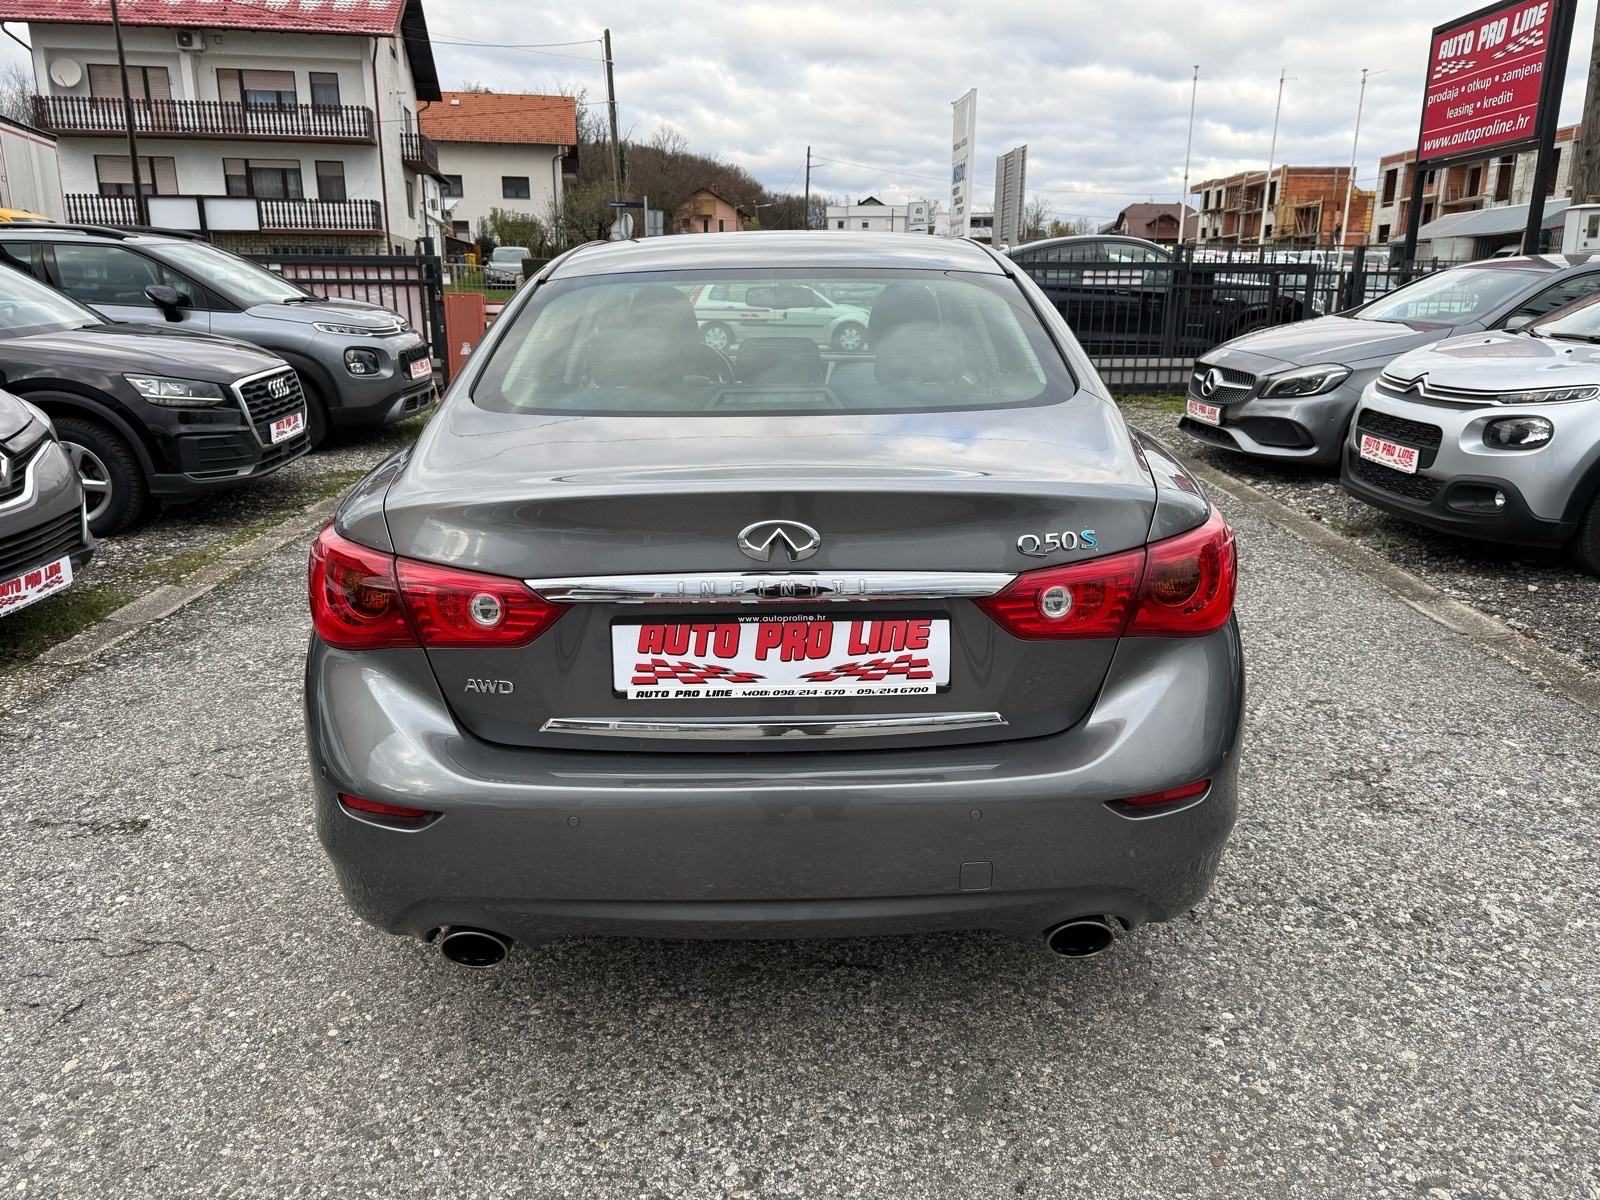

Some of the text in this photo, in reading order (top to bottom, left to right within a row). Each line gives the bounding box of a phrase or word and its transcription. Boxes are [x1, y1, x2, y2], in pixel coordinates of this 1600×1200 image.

[1438, 1, 1549, 60] AUTO PRO LINE
[1427, 62, 1542, 107] prodaja otkup zamjena
[1446, 89, 1514, 119] leasing krediti
[1423, 113, 1530, 151] www.autoproline.hr
[1364, 437, 1416, 460] AUTO PRO LINE
[25, 569, 42, 590] PRO
[677, 579, 867, 597] INFINITI
[737, 613, 827, 624] www.autoproline.hr
[637, 619, 933, 662] AUTO PRO LINE
[463, 678, 514, 694] AWD
[635, 690, 670, 698] AUTO
[674, 689, 701, 698] PRO
[705, 689, 733, 697] LINE
[741, 689, 771, 697] MOB:
